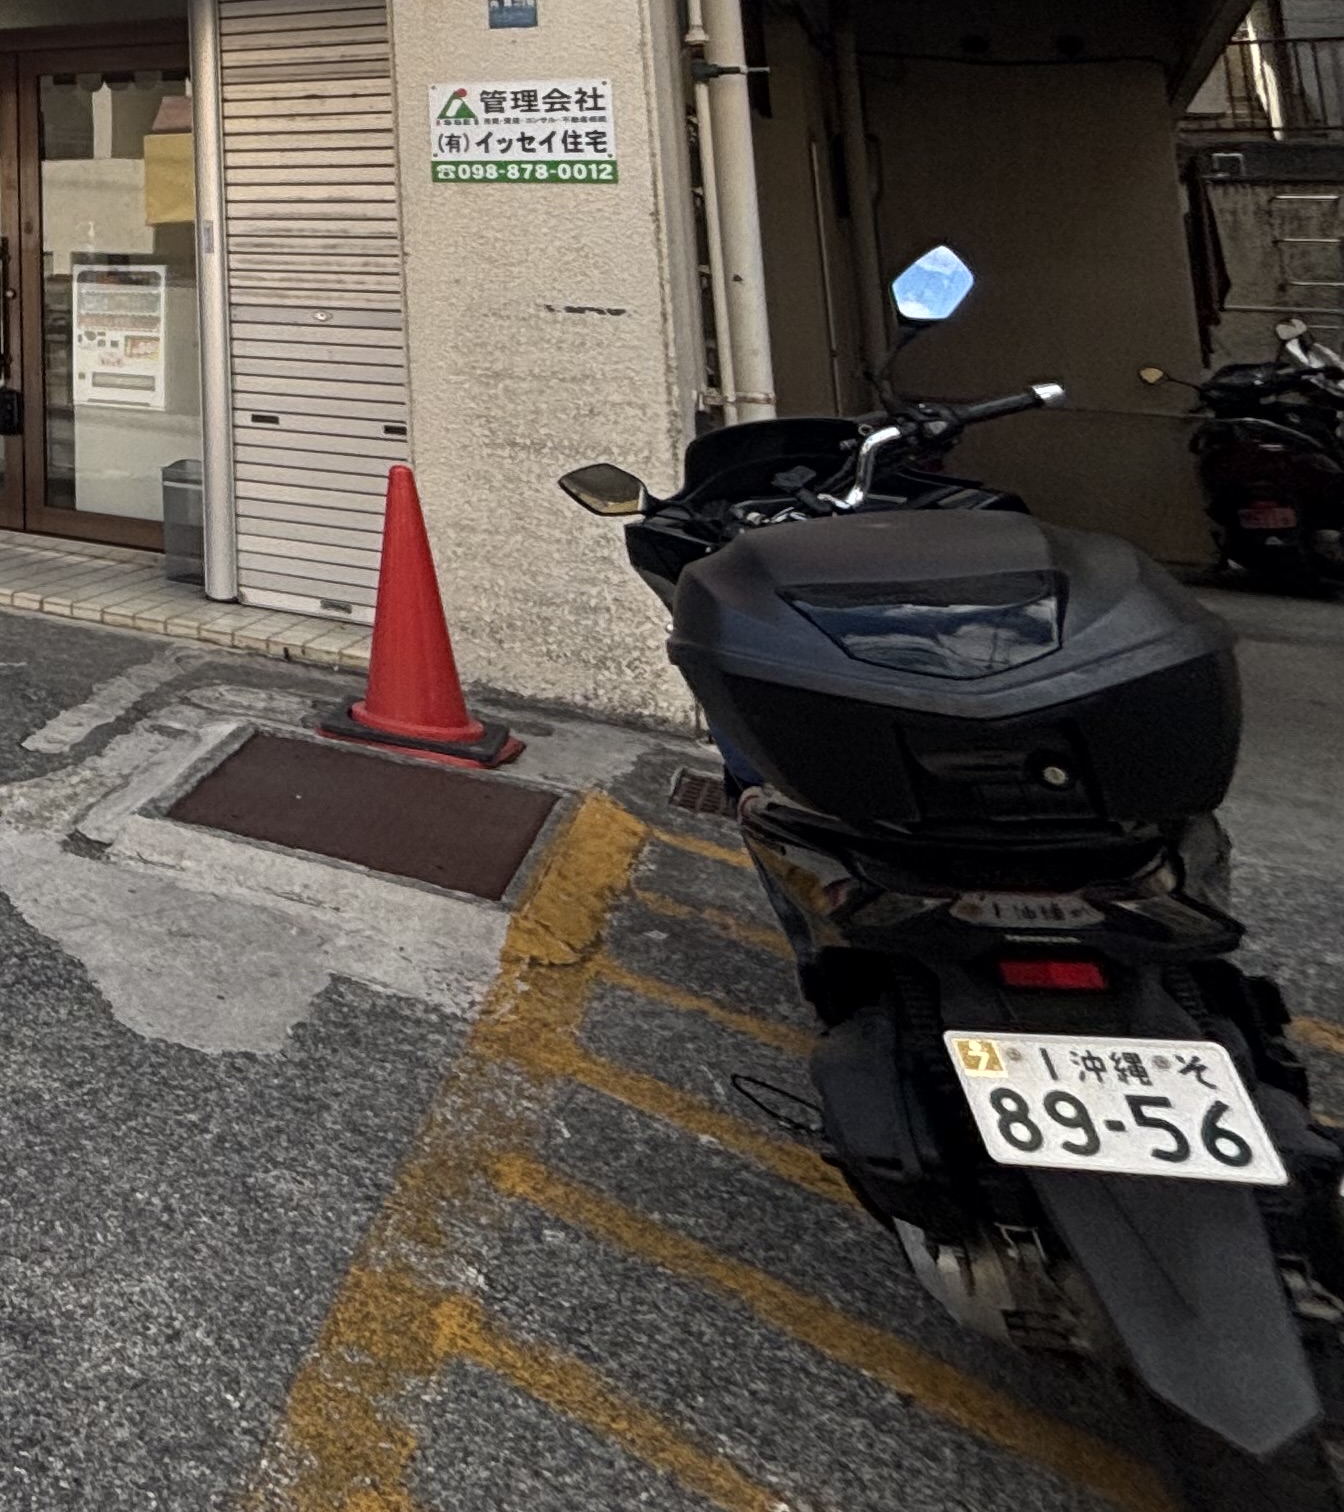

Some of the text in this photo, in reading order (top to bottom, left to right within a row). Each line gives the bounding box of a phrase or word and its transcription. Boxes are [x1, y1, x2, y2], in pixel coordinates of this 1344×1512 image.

[479, 87, 606, 114] 管理会社
[458, 164, 613, 179] 098-878-0012
[1070, 1050, 1153, 1086] 沖縄
[1173, 1053, 1218, 1088] そ
[989, 1087, 1253, 1168] 89-56
